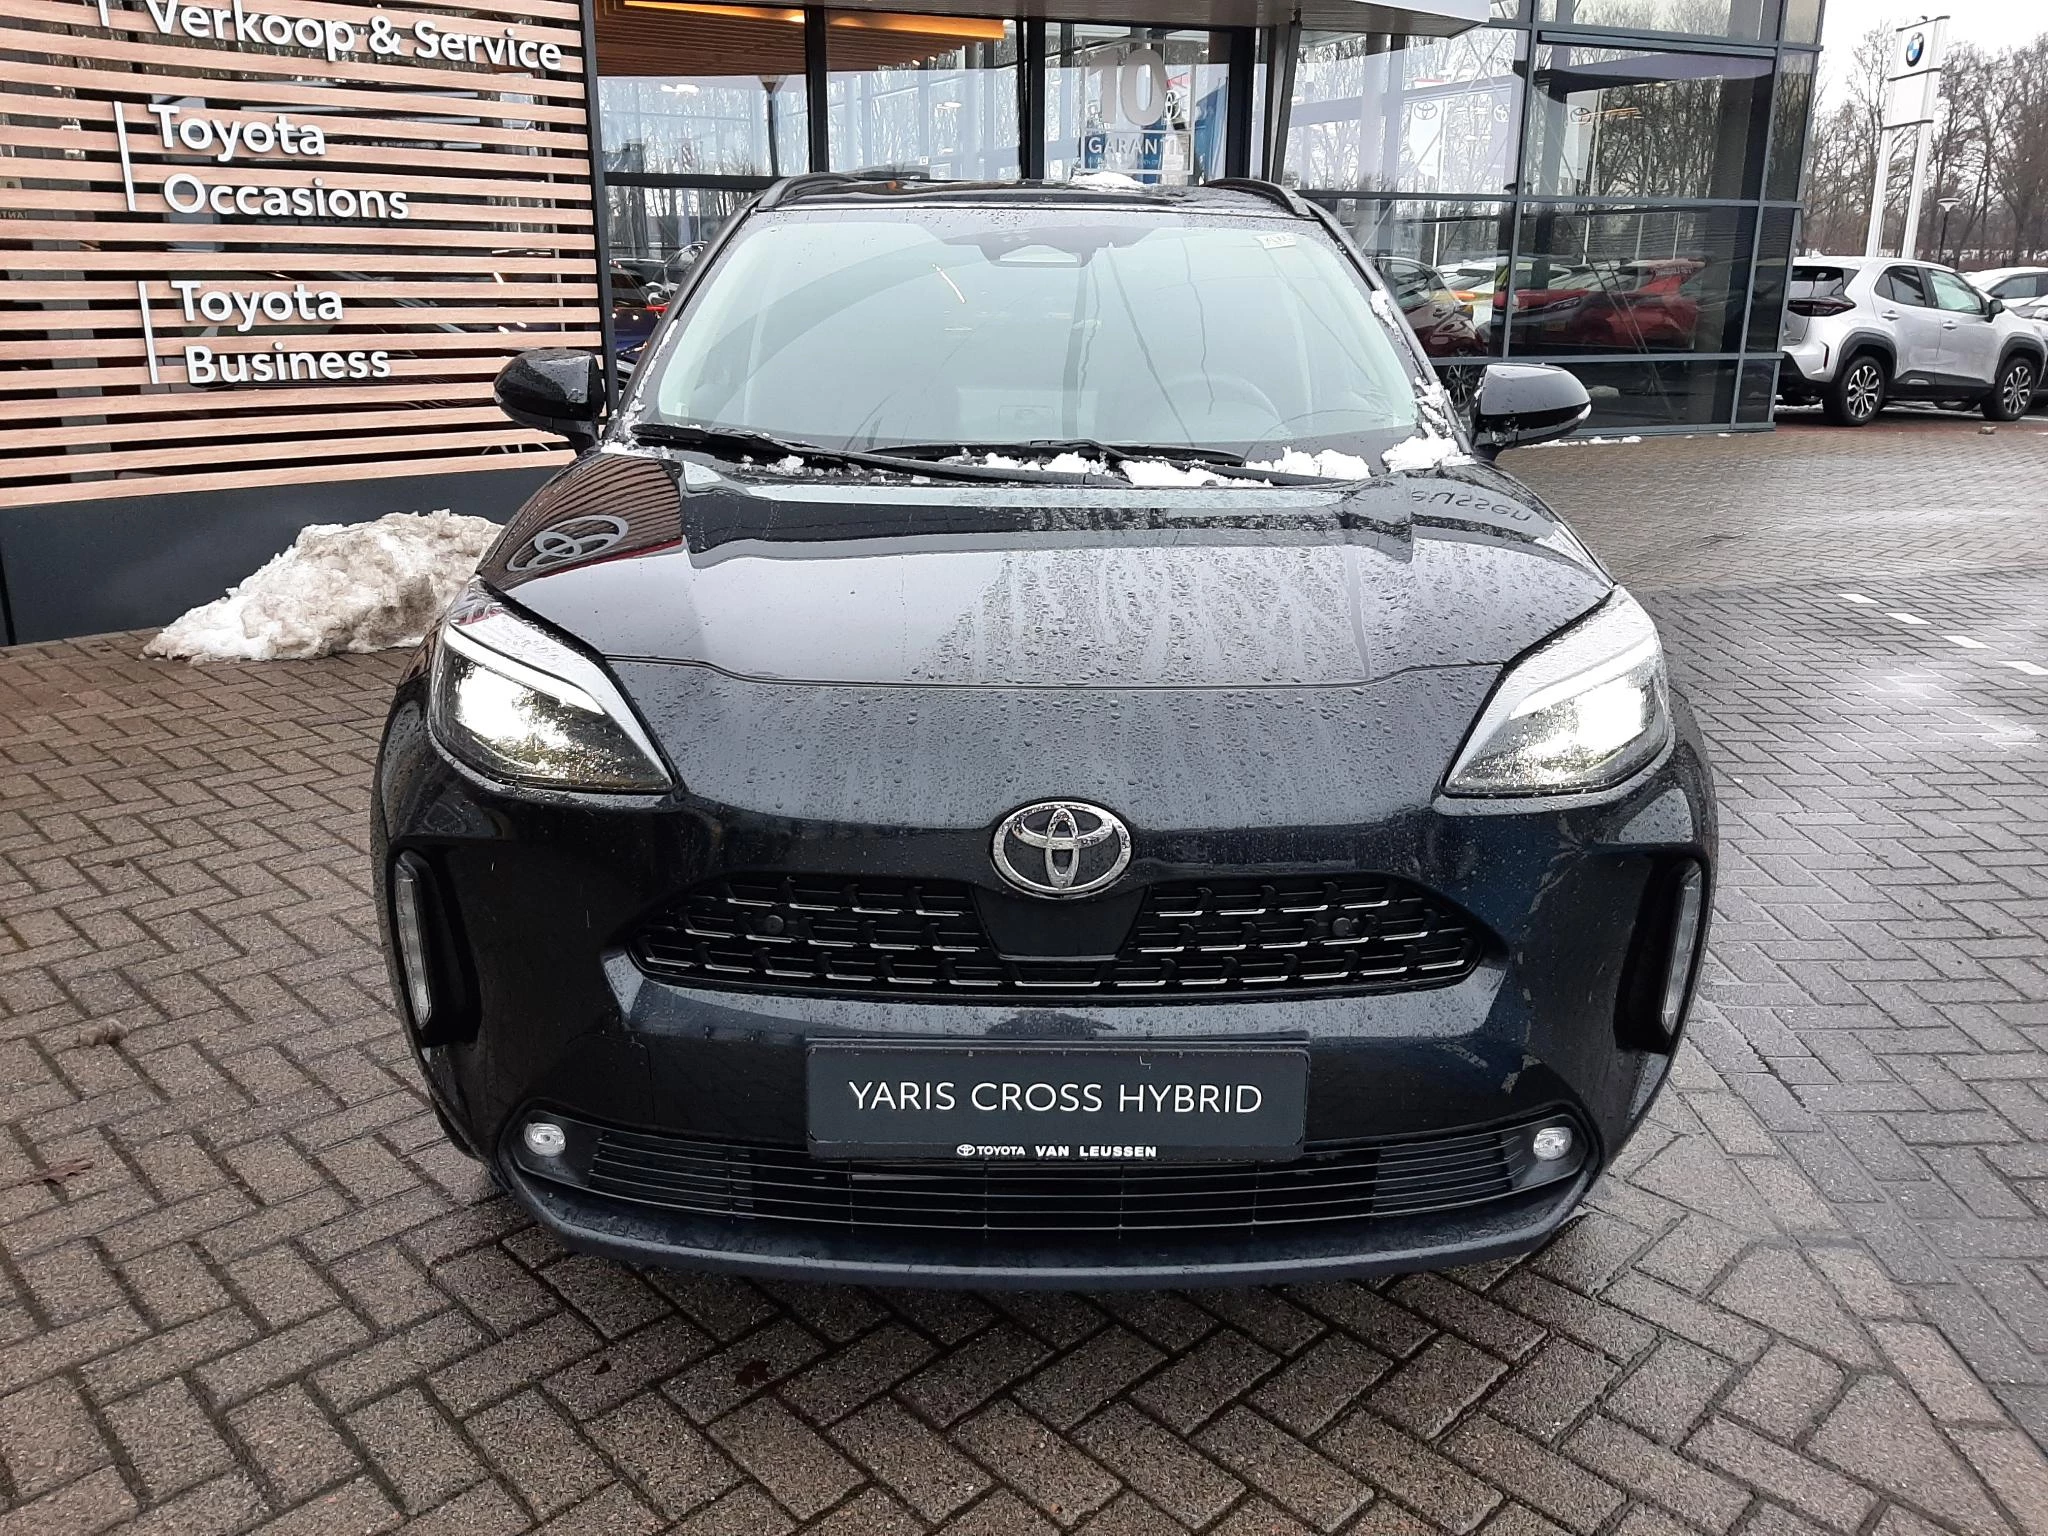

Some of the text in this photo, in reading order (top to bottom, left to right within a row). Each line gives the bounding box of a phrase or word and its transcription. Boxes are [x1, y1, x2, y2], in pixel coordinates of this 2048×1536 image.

[147, 0, 563, 71] Verkoop & Service
[1087, 49, 1169, 126] 10
[149, 103, 326, 161] Toyota
[163, 173, 409, 220] Occasions
[171, 280, 344, 332] Toyota
[184, 343, 391, 384] Business
[849, 1082, 1263, 1113] YARIS CROSS HYBRID
[977, 1145, 1157, 1158] TOYOTA VAN LEUSSEN
